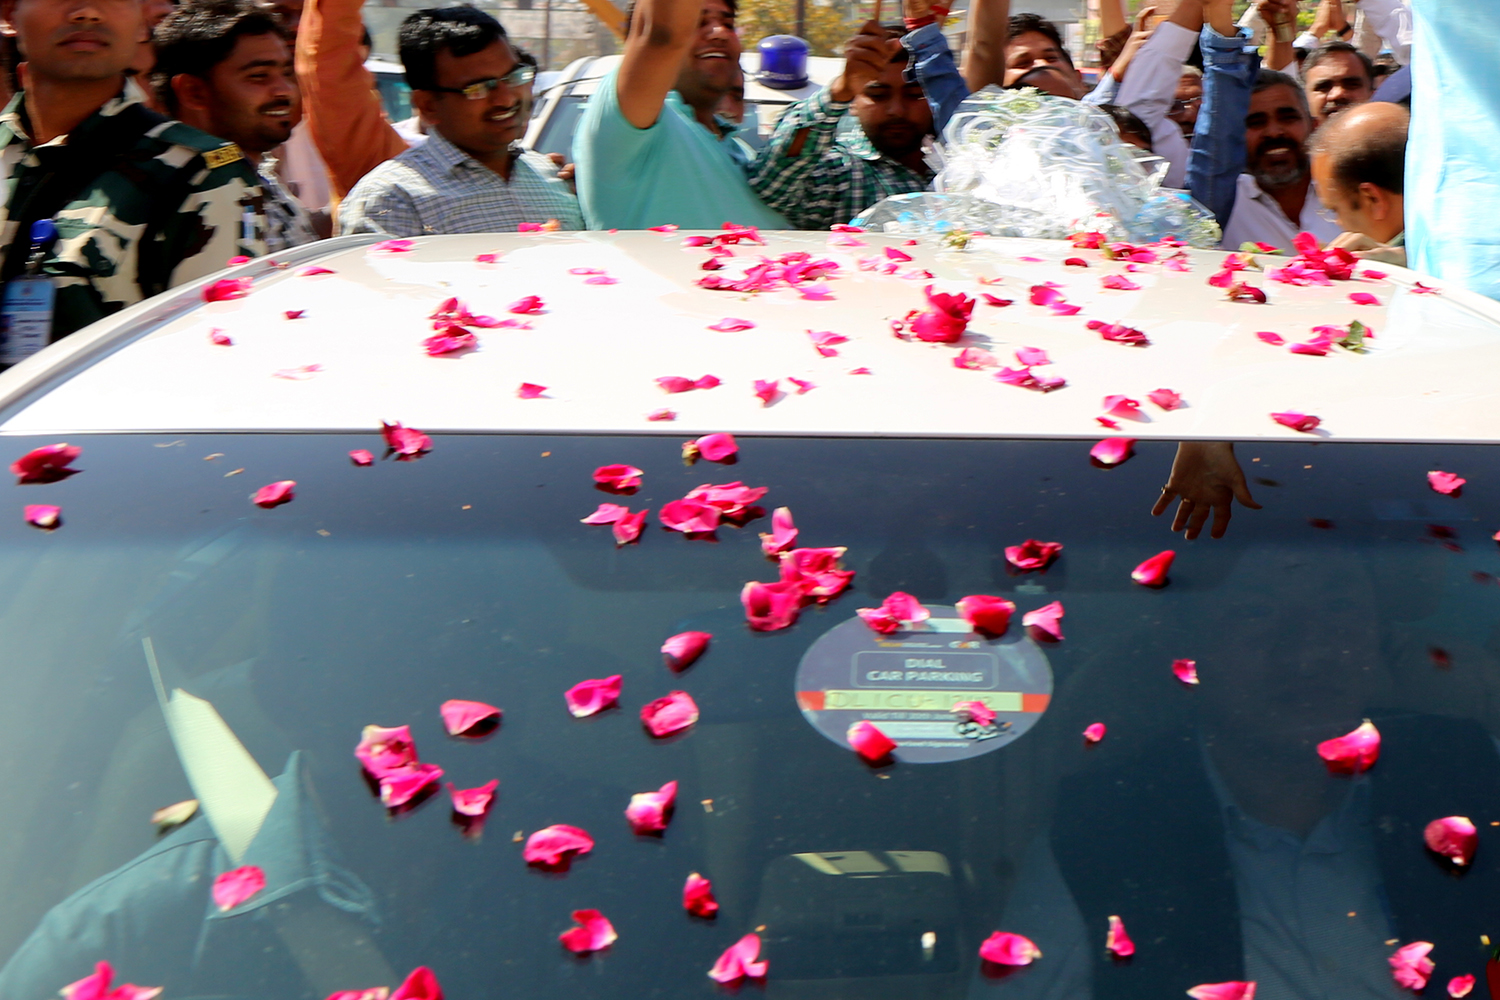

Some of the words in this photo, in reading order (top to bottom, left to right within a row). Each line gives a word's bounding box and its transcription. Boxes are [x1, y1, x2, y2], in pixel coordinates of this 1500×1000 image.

[904, 658, 947, 669] DIAL
[866, 670, 903, 682] CAR
[904, 671, 984, 683] PARKING
